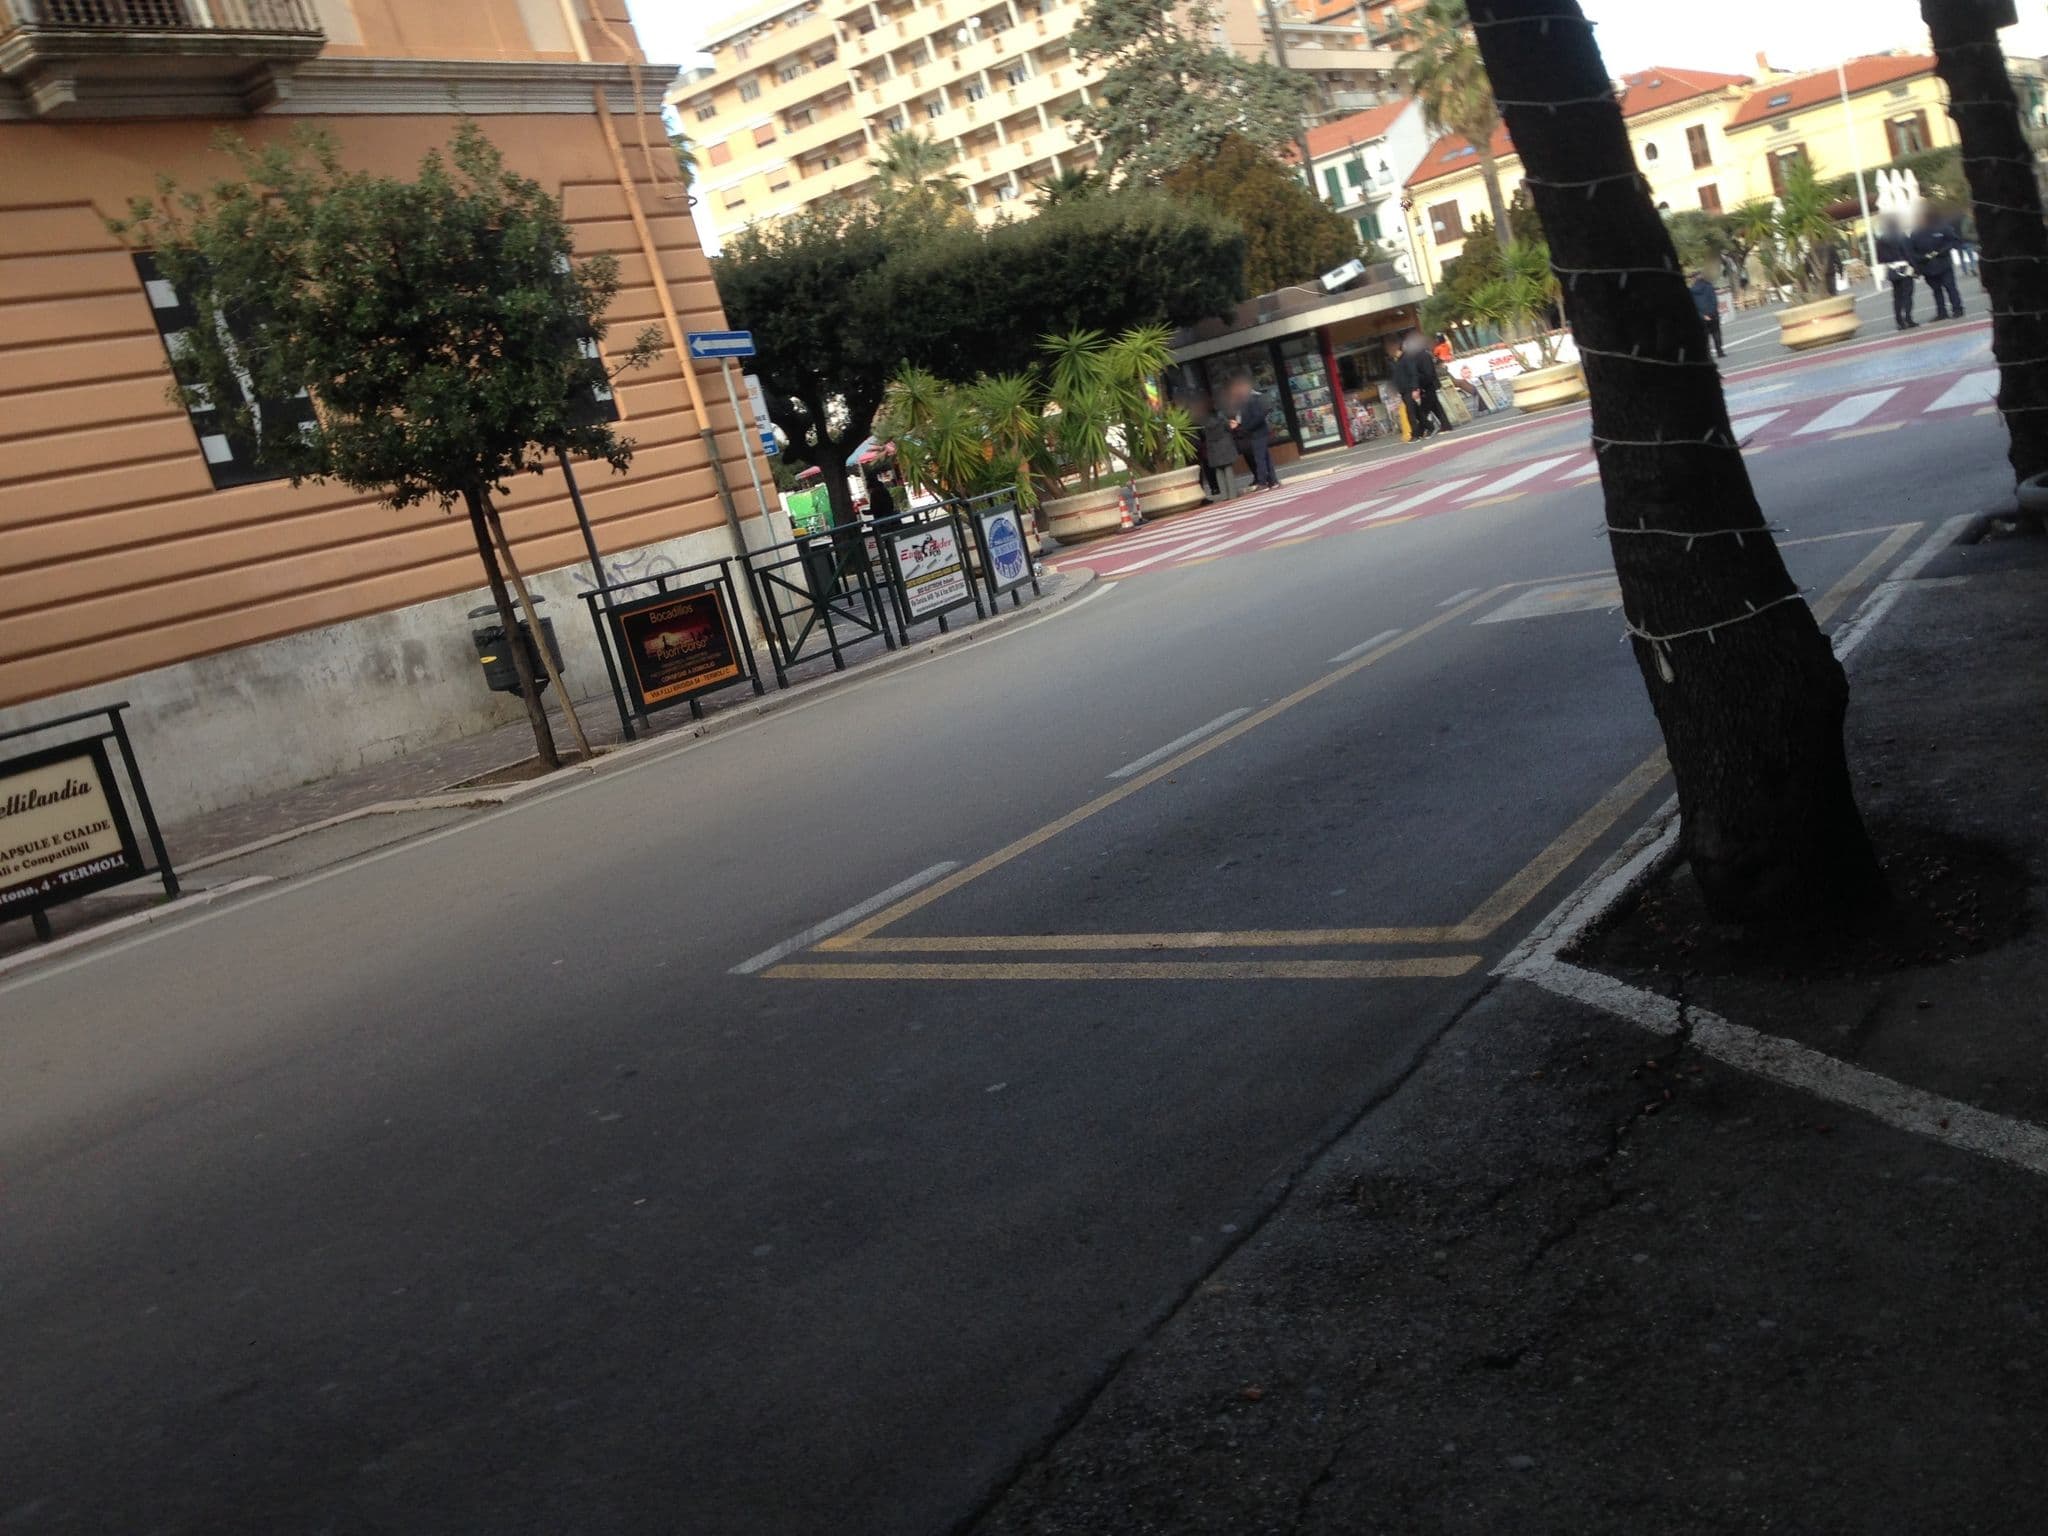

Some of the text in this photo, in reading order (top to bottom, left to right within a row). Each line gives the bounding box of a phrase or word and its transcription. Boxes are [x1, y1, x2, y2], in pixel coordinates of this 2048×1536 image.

[649, 604, 694, 624] Bocadillos
[51, 833, 62, 846] E
[63, 819, 111, 842] CIALDE
[22, 840, 91, 870] Compatibili
[41, 880, 51, 892] 4
[58, 854, 126, 884] TERMOLI
